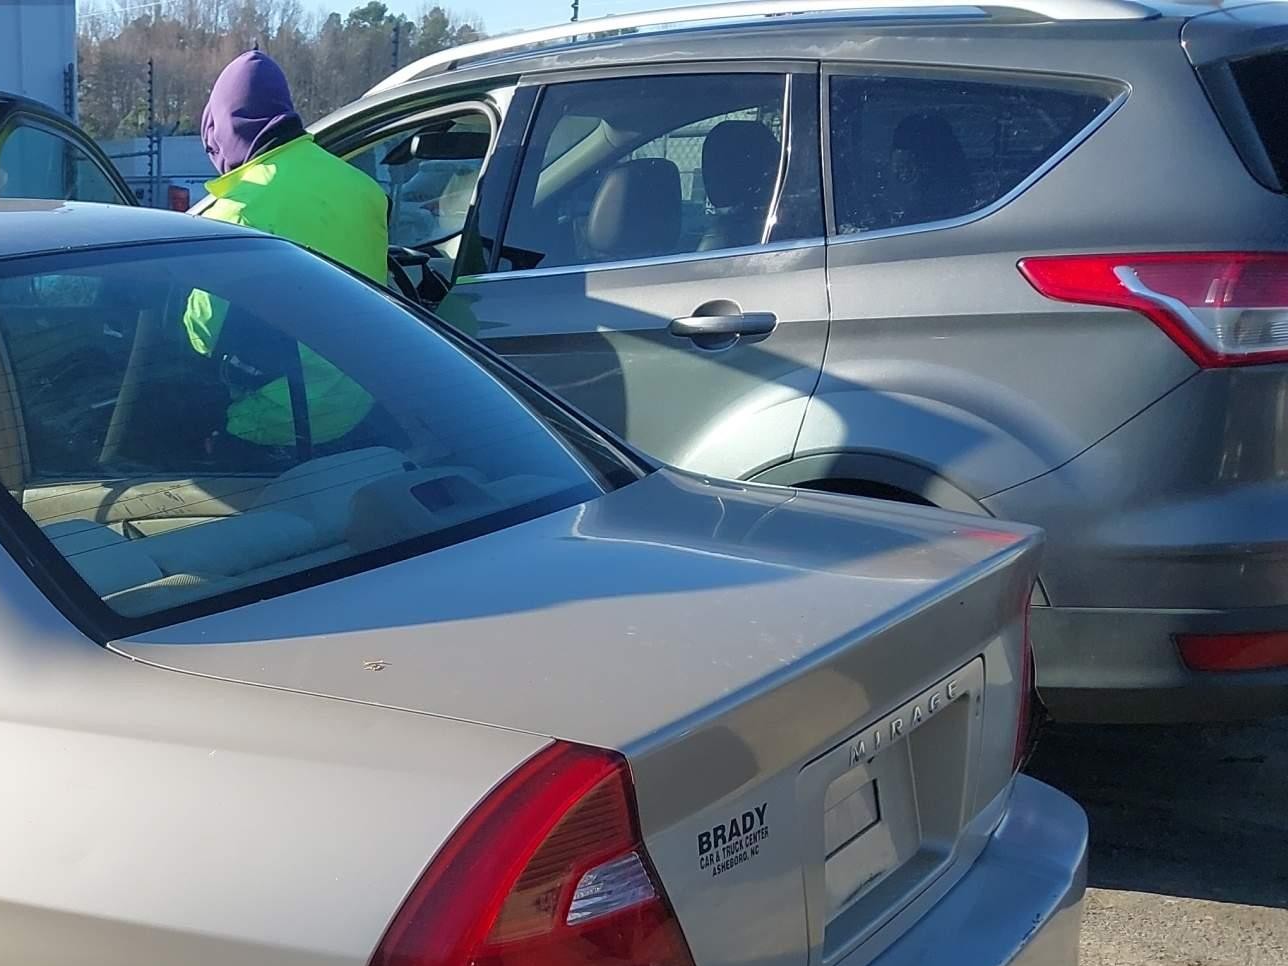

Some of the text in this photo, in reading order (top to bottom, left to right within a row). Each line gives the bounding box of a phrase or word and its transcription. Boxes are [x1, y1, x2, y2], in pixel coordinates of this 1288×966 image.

[849, 680, 958, 768] MIRAGE
[698, 803, 768, 856] BRADY
[699, 853, 715, 871] CAR
[722, 839, 744, 859] TRUCK
[744, 826, 769, 848] CENTER
[750, 844, 760, 859] NC
